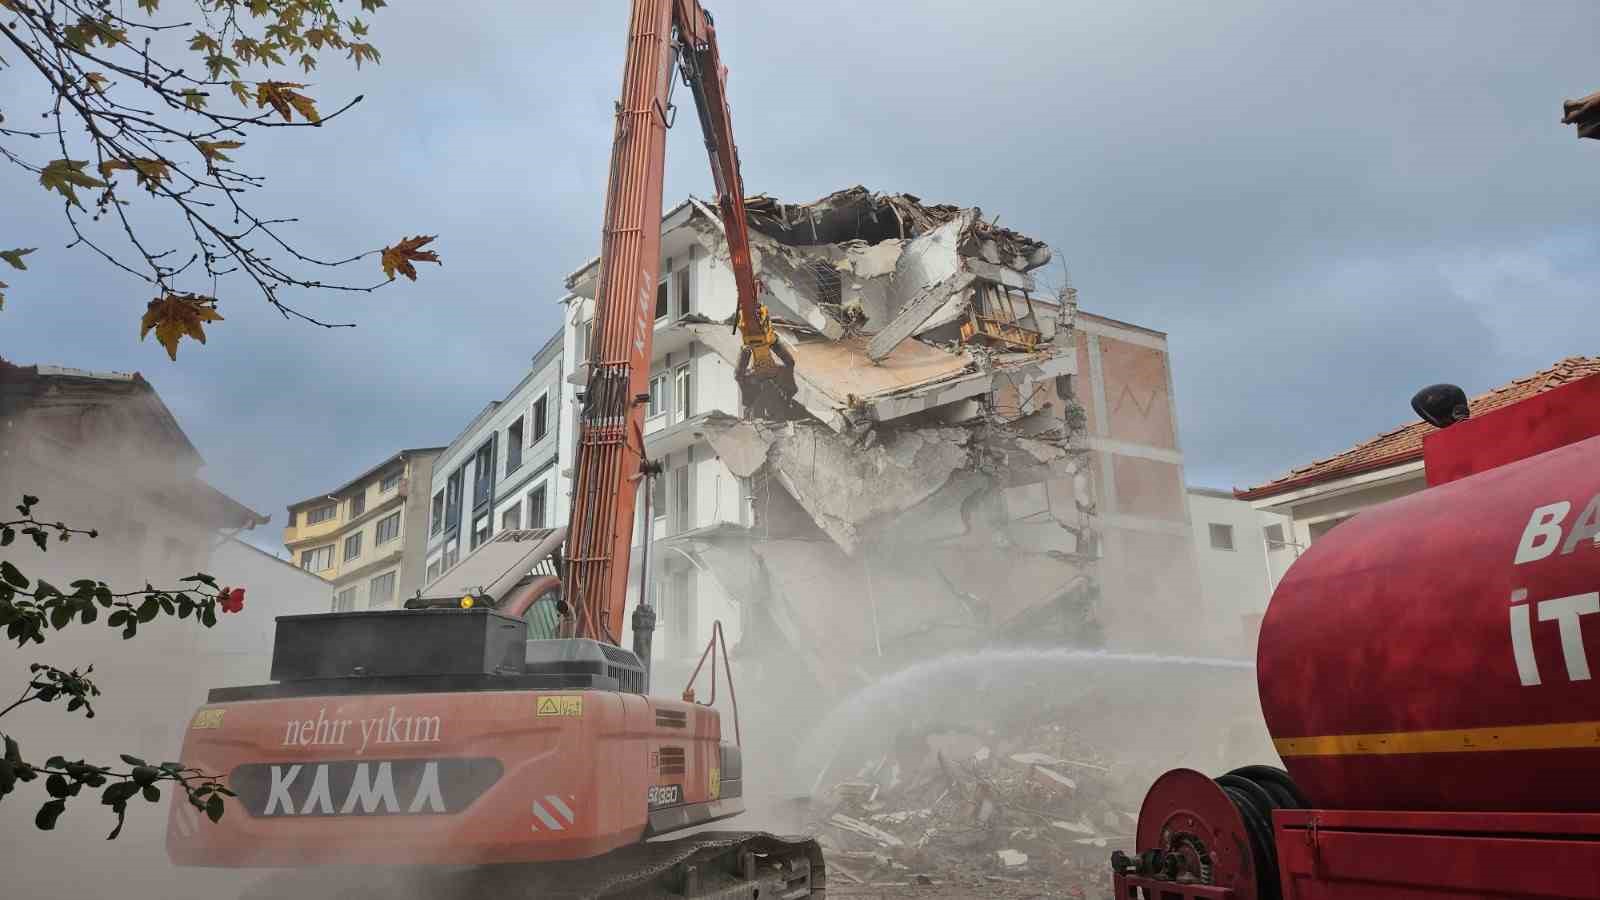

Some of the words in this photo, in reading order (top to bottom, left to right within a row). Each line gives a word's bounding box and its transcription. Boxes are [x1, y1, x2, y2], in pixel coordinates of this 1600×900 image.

[281, 703, 353, 747] nehir
[355, 703, 441, 756] yıkım
[263, 761, 447, 815] KAMA
